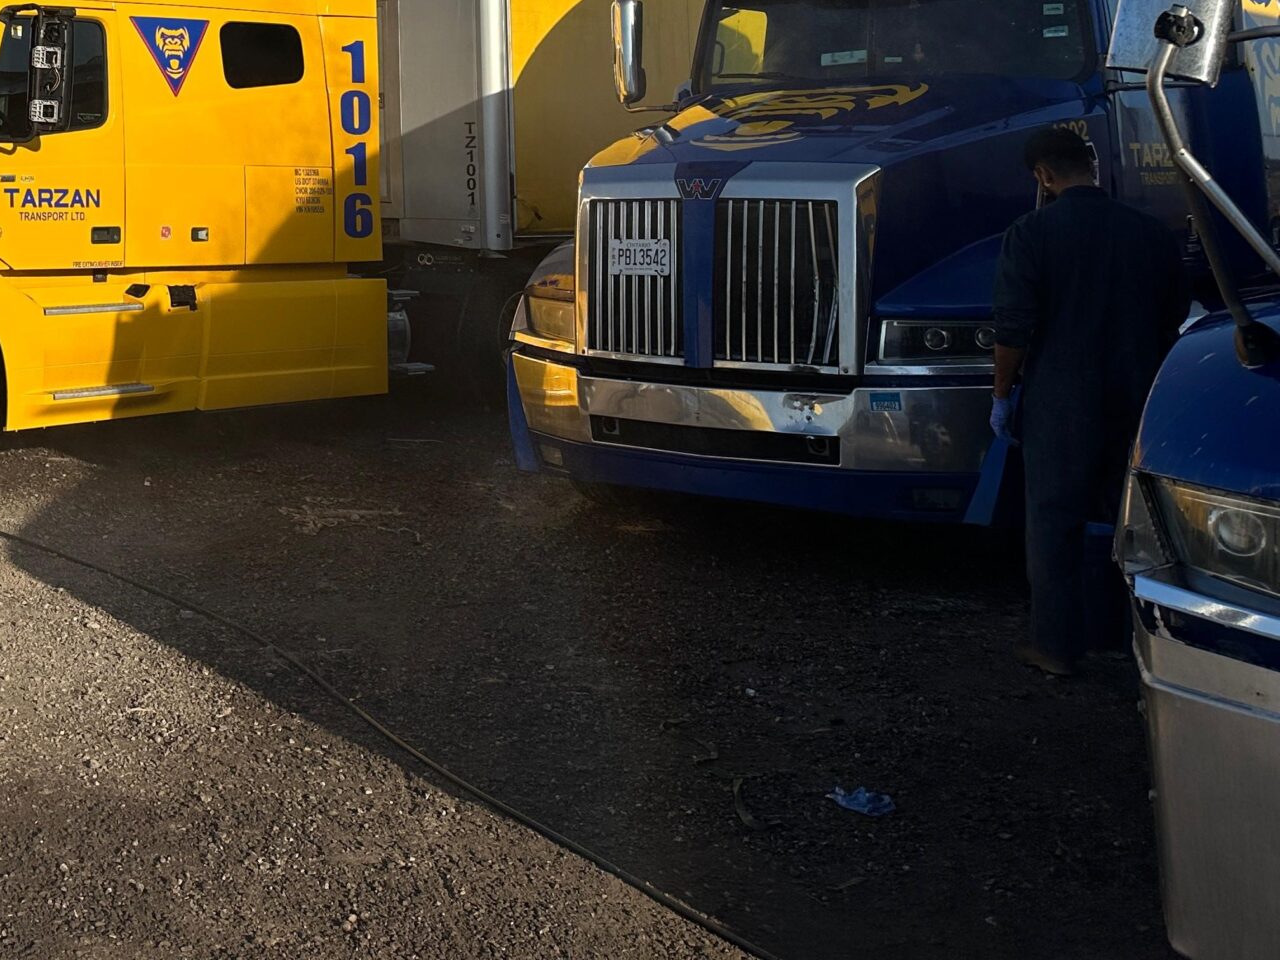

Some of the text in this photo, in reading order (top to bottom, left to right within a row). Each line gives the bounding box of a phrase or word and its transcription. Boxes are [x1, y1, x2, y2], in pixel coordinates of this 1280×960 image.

[340, 40, 373, 239] 1016
[464, 121, 477, 206] TZ1001
[4, 188, 101, 208] TARZAN
[20, 212, 69, 221] TRANSPORT
[618, 248, 667, 266] PB13542
